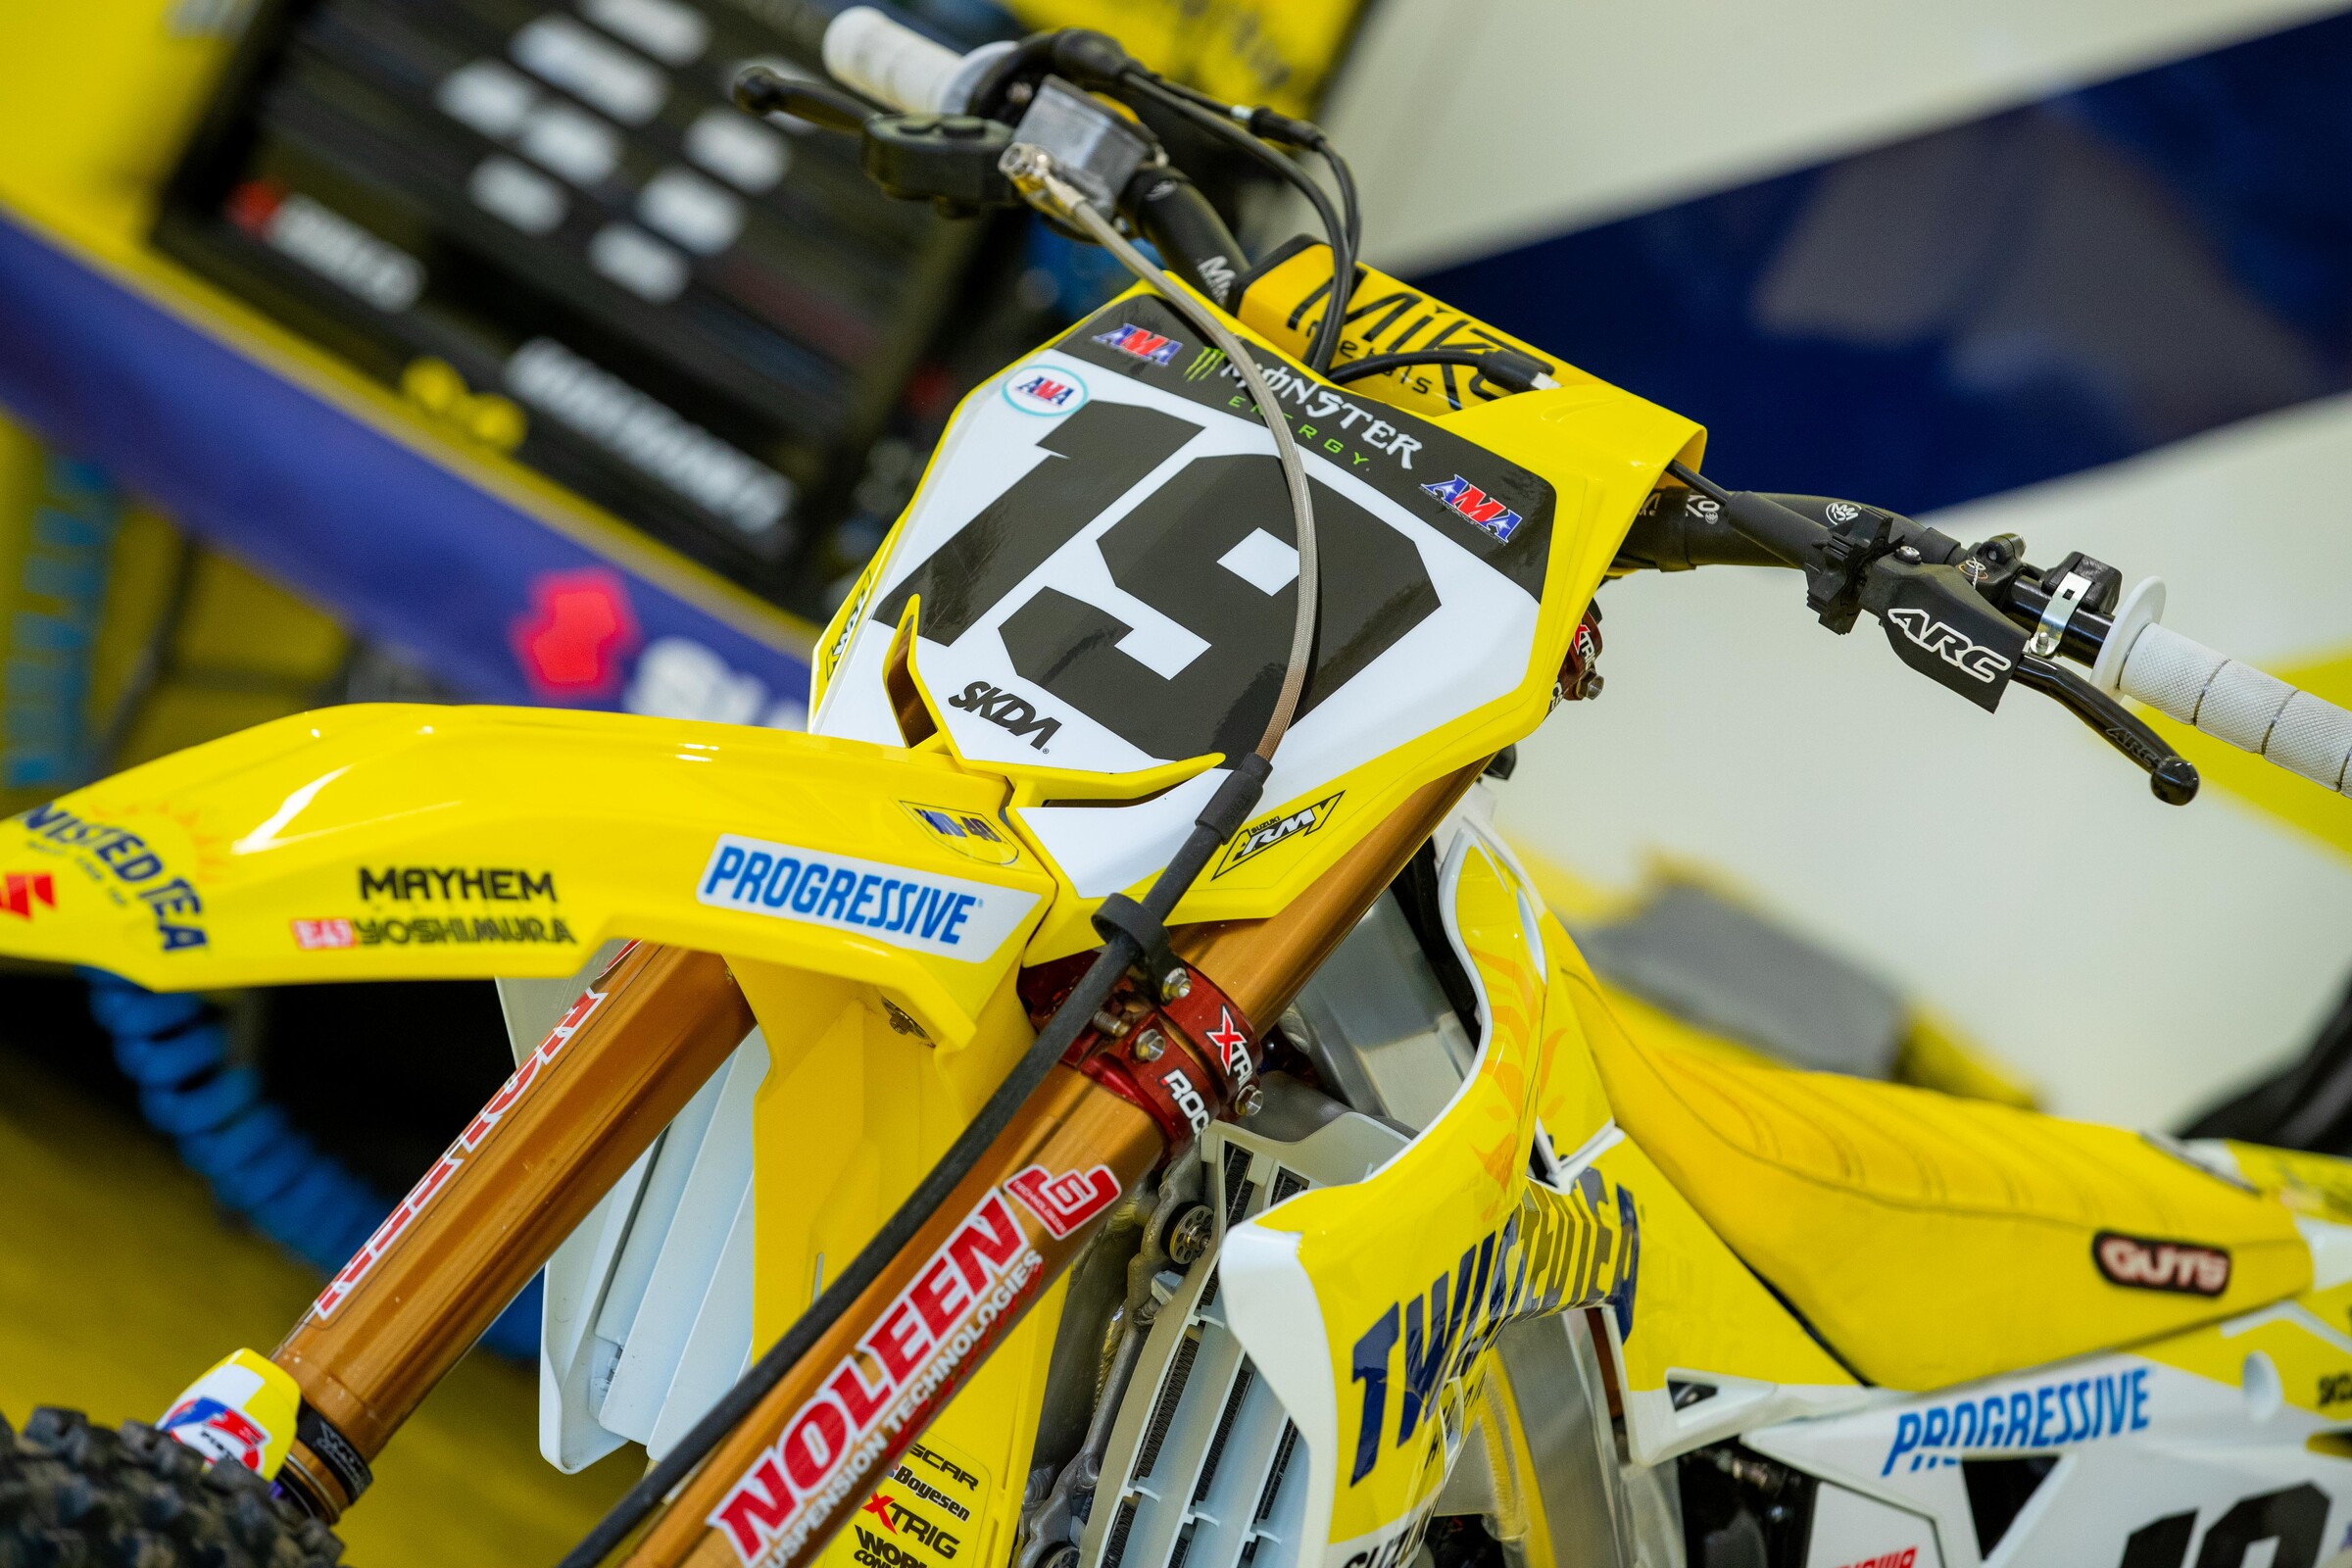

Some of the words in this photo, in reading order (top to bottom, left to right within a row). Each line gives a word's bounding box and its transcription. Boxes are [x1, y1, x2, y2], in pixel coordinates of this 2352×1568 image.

[1093, 322, 1183, 368] AMA
[1018, 375, 1075, 408] AMA
[1420, 473, 1523, 544] AMA
[872, 399, 1442, 770] 19
[1887, 608, 2012, 684] ARC
[948, 681, 1063, 751] SKDA
[1250, 815, 1282, 834] SUZUKI
[137, 877, 209, 952] TEA
[358, 866, 558, 903] MAYHEM
[705, 845, 978, 946] PROGRESSIVE
[352, 915, 579, 945] YOSHIMURA
[708, 1188, 1030, 1568] NOLEEN
[757, 1430, 890, 1568] USPENSION
[883, 1248, 1044, 1435] TECHNOLOGIES
[1881, 1367, 2151, 1478] PROGRESSIVE
[861, 1490, 960, 1560] XTRIG
[893, 1465, 971, 1523] Boyesen
[855, 1524, 928, 1568] WOR
